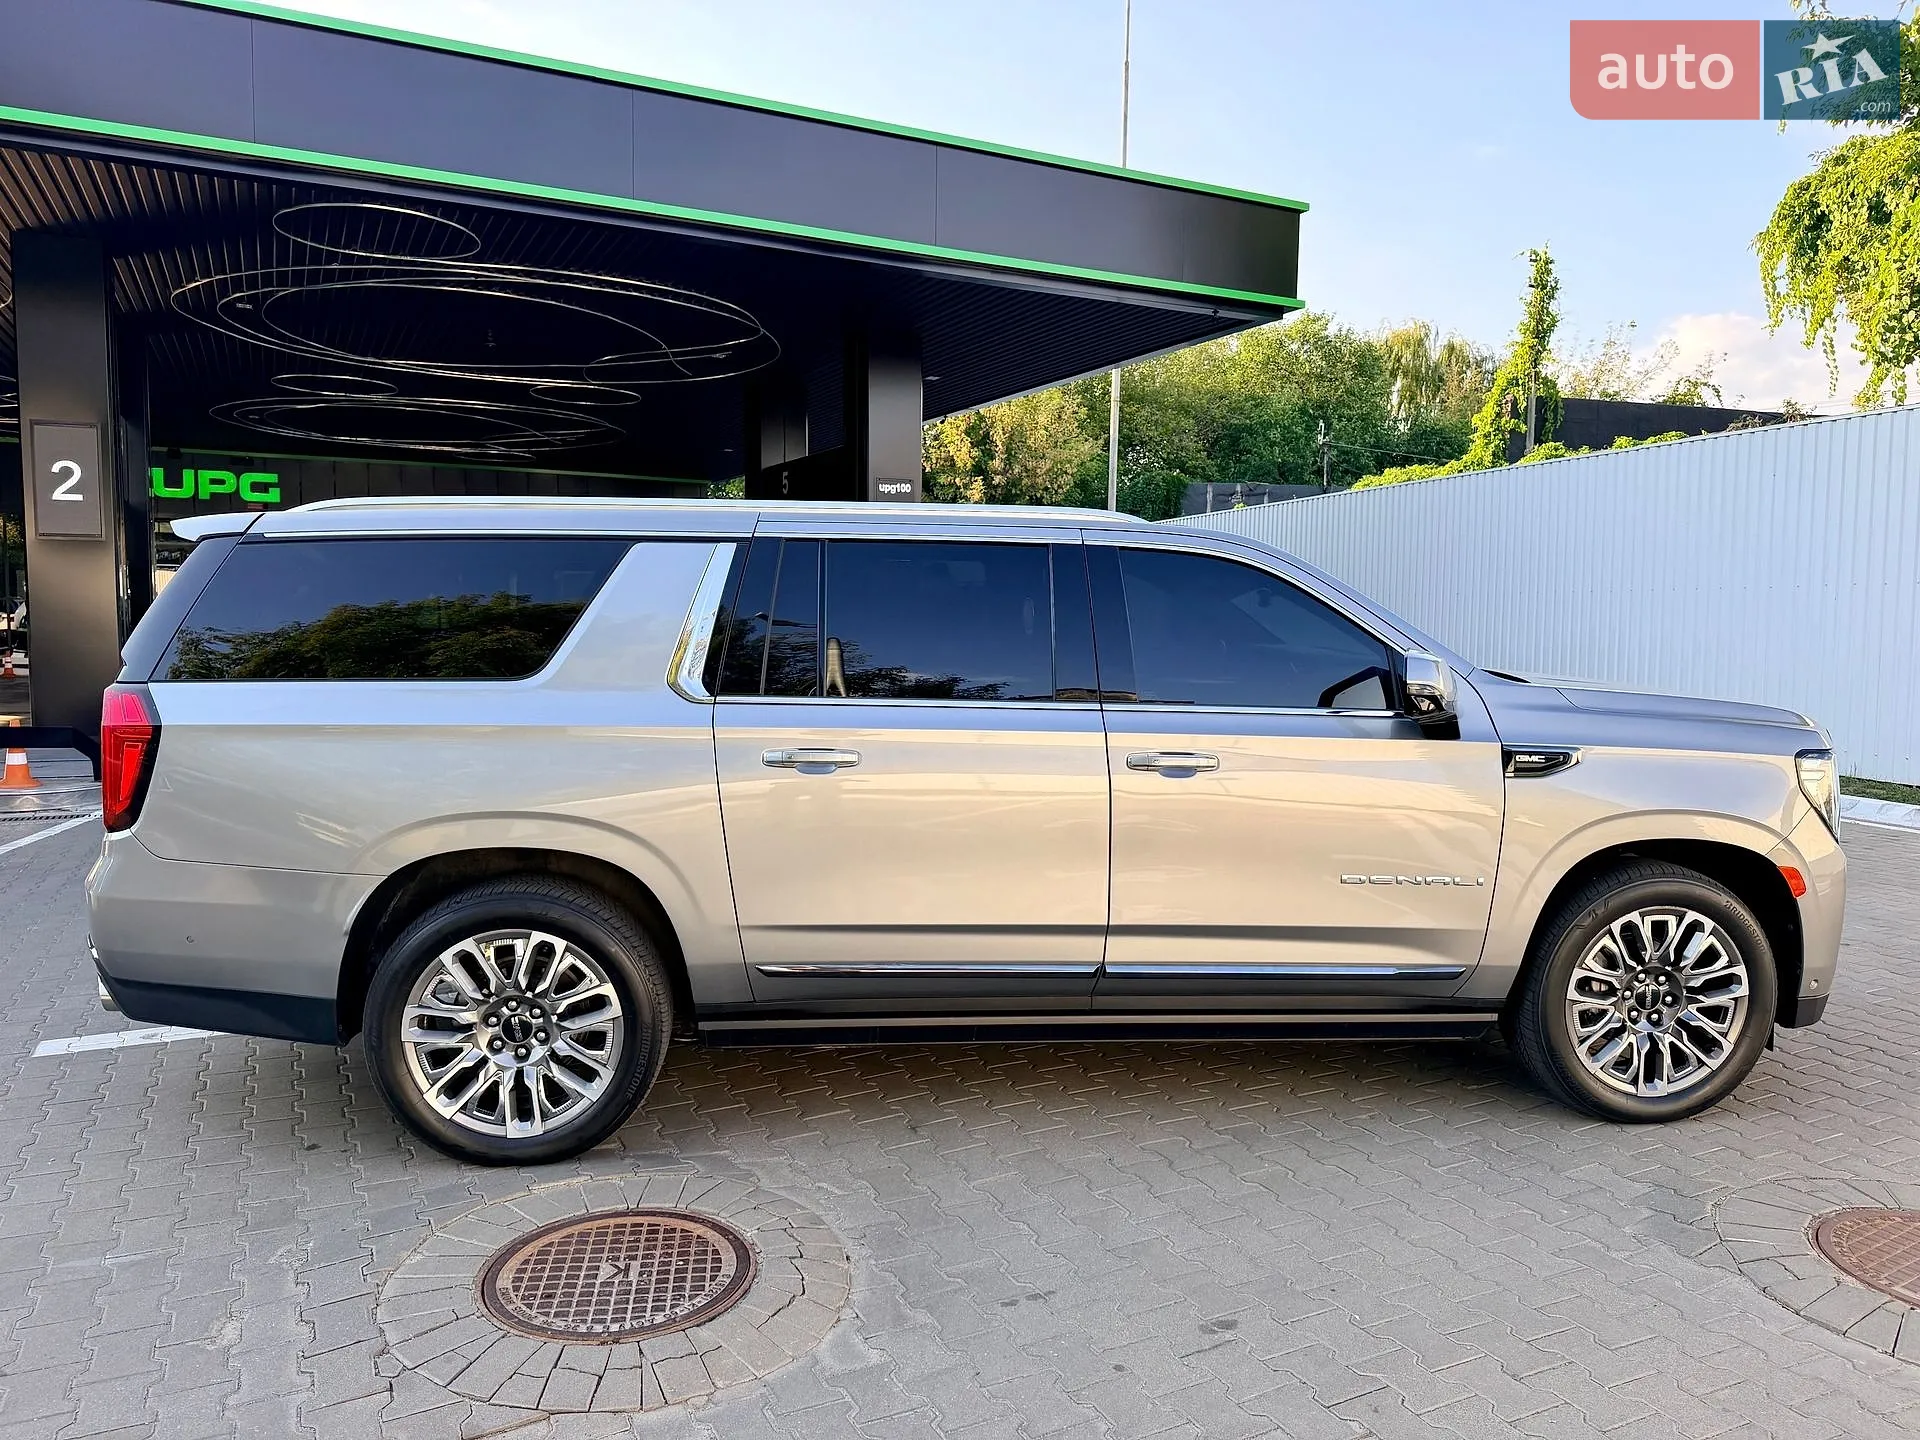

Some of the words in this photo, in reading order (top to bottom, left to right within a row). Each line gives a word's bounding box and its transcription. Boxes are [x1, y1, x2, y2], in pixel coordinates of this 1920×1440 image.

[50, 460, 84, 502] 2
[151, 467, 281, 503] UPG
[782, 471, 789, 495] 5
[878, 483, 912, 495] upg100
[1515, 754, 1546, 763] GMC
[1340, 874, 1485, 887] DENALI
